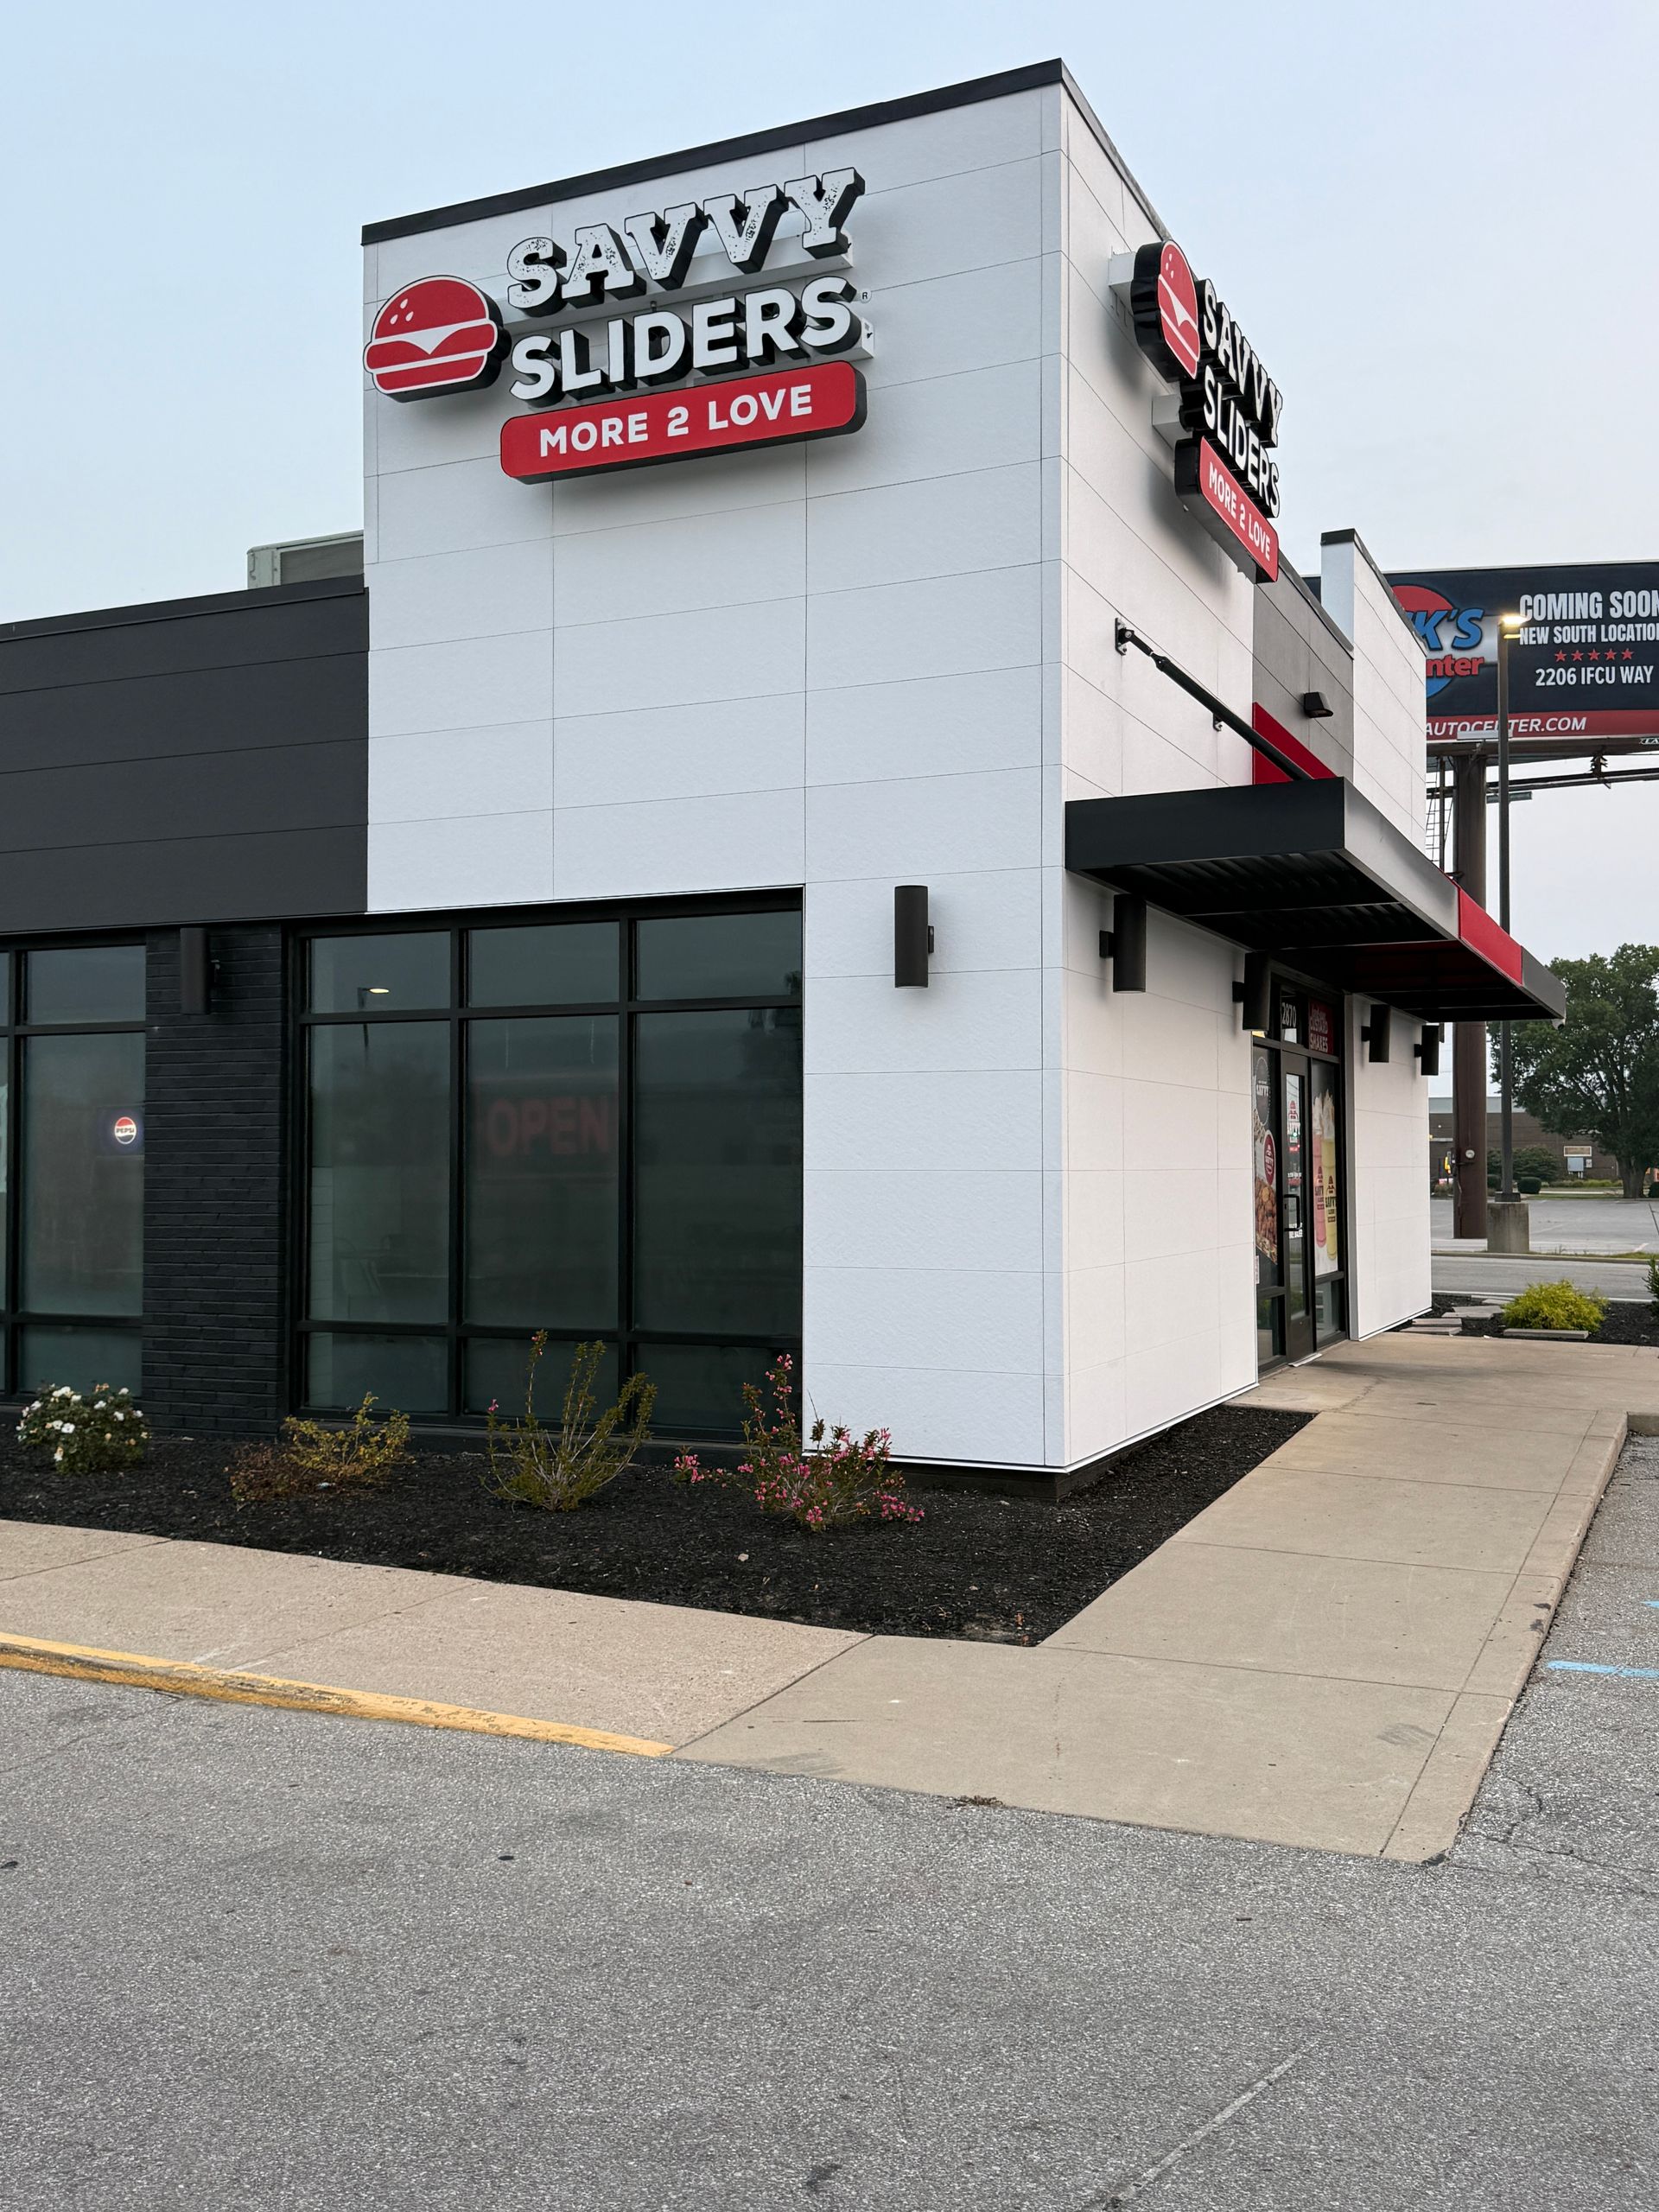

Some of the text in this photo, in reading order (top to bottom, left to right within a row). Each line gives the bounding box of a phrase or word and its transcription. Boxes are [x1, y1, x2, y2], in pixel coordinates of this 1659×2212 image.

[506, 167, 860, 311] SAVVY
[509, 276, 855, 401] SLIDERS
[1203, 278, 1283, 448] SAVVY
[539, 385, 813, 458] MORE 2 LOVE
[1203, 365, 1281, 518] SLIDERS
[1209, 461, 1271, 562] MORE 2 LOVE
[1519, 591, 1603, 621] COMING
[1519, 626, 1549, 645] NEW
[1554, 625, 1597, 644] SOUTH
[1426, 654, 1485, 677] nter
[1535, 665, 1654, 686] 2206 IFCU WAY
[1426, 716, 1587, 736] AUTOCETER.COM
[1281, 1002, 1297, 1028] 2870
[485, 1095, 610, 1158] OPEN
